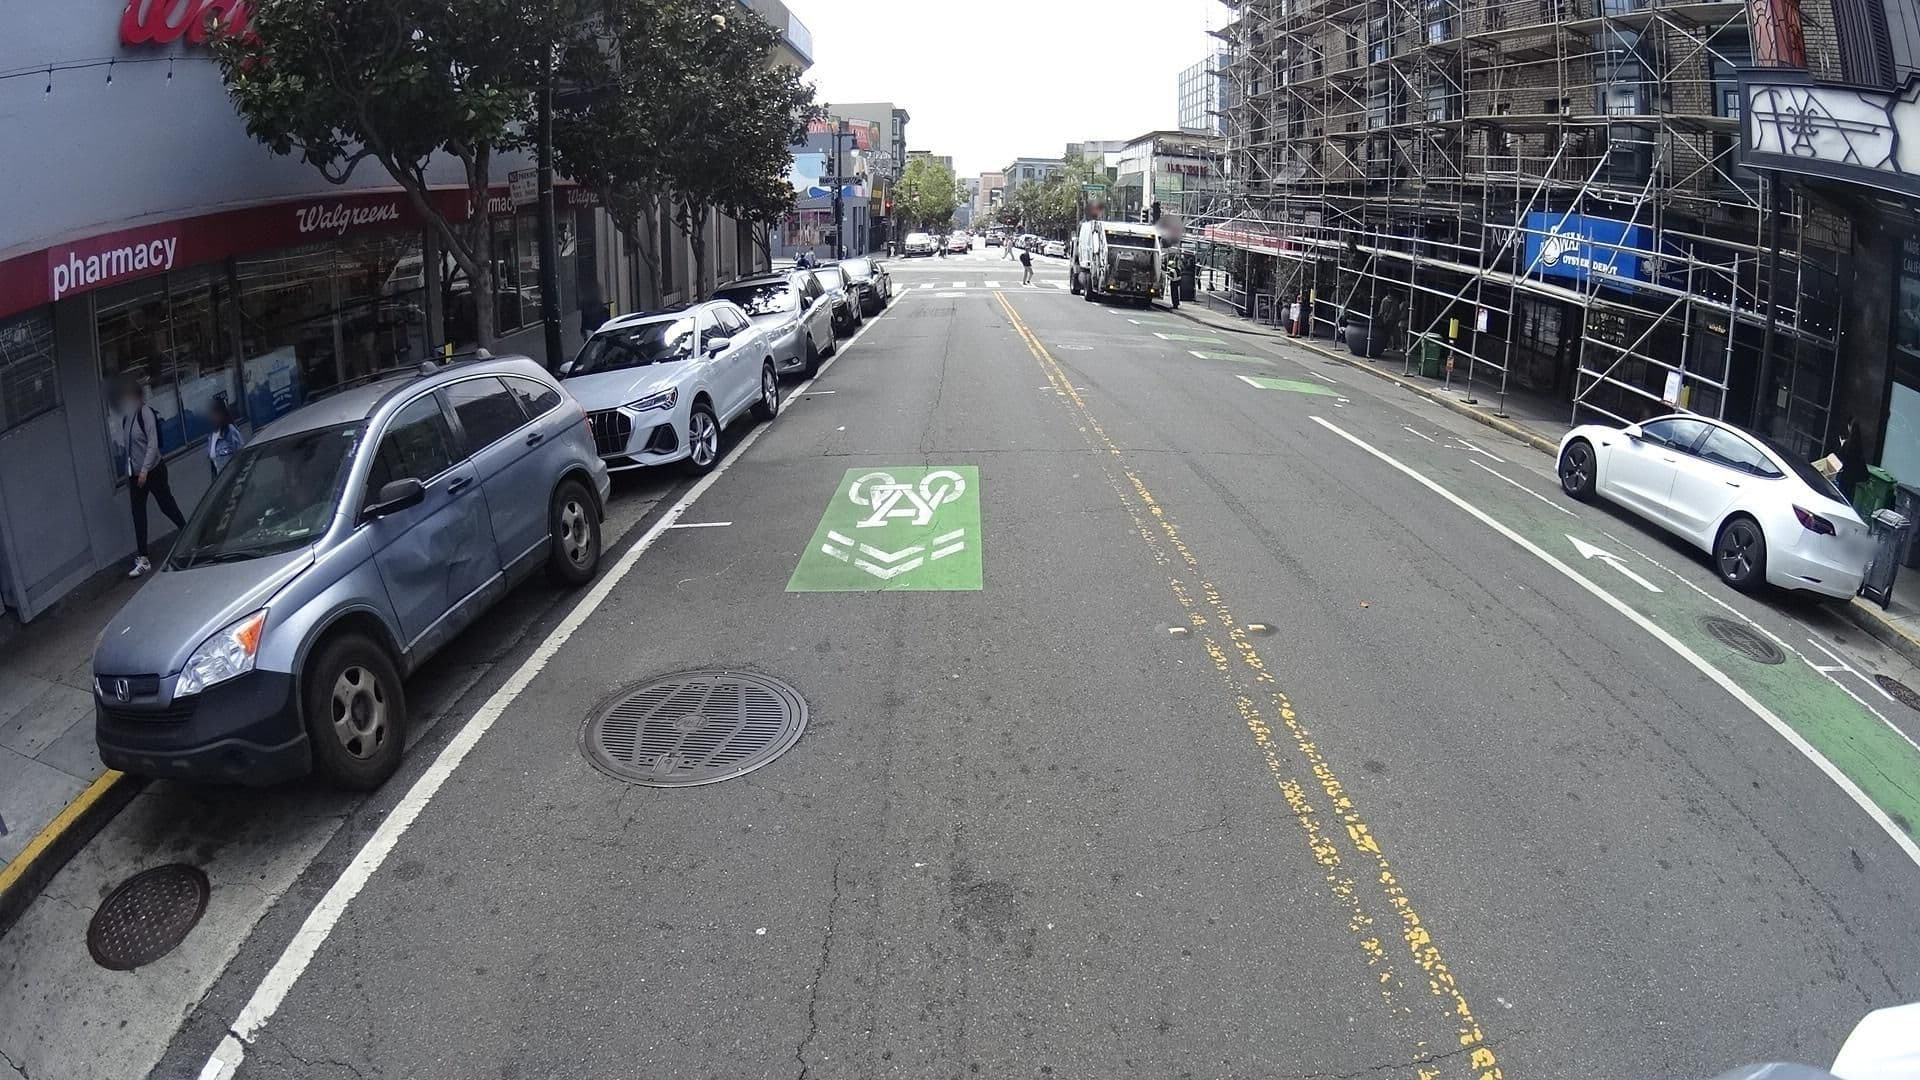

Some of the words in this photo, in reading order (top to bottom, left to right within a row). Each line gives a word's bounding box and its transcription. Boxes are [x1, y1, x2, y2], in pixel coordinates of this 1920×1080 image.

[296, 203, 400, 235] Walgreens
[54, 237, 177, 301] pharmacy
[1562, 255, 1590, 268] OYSTER
